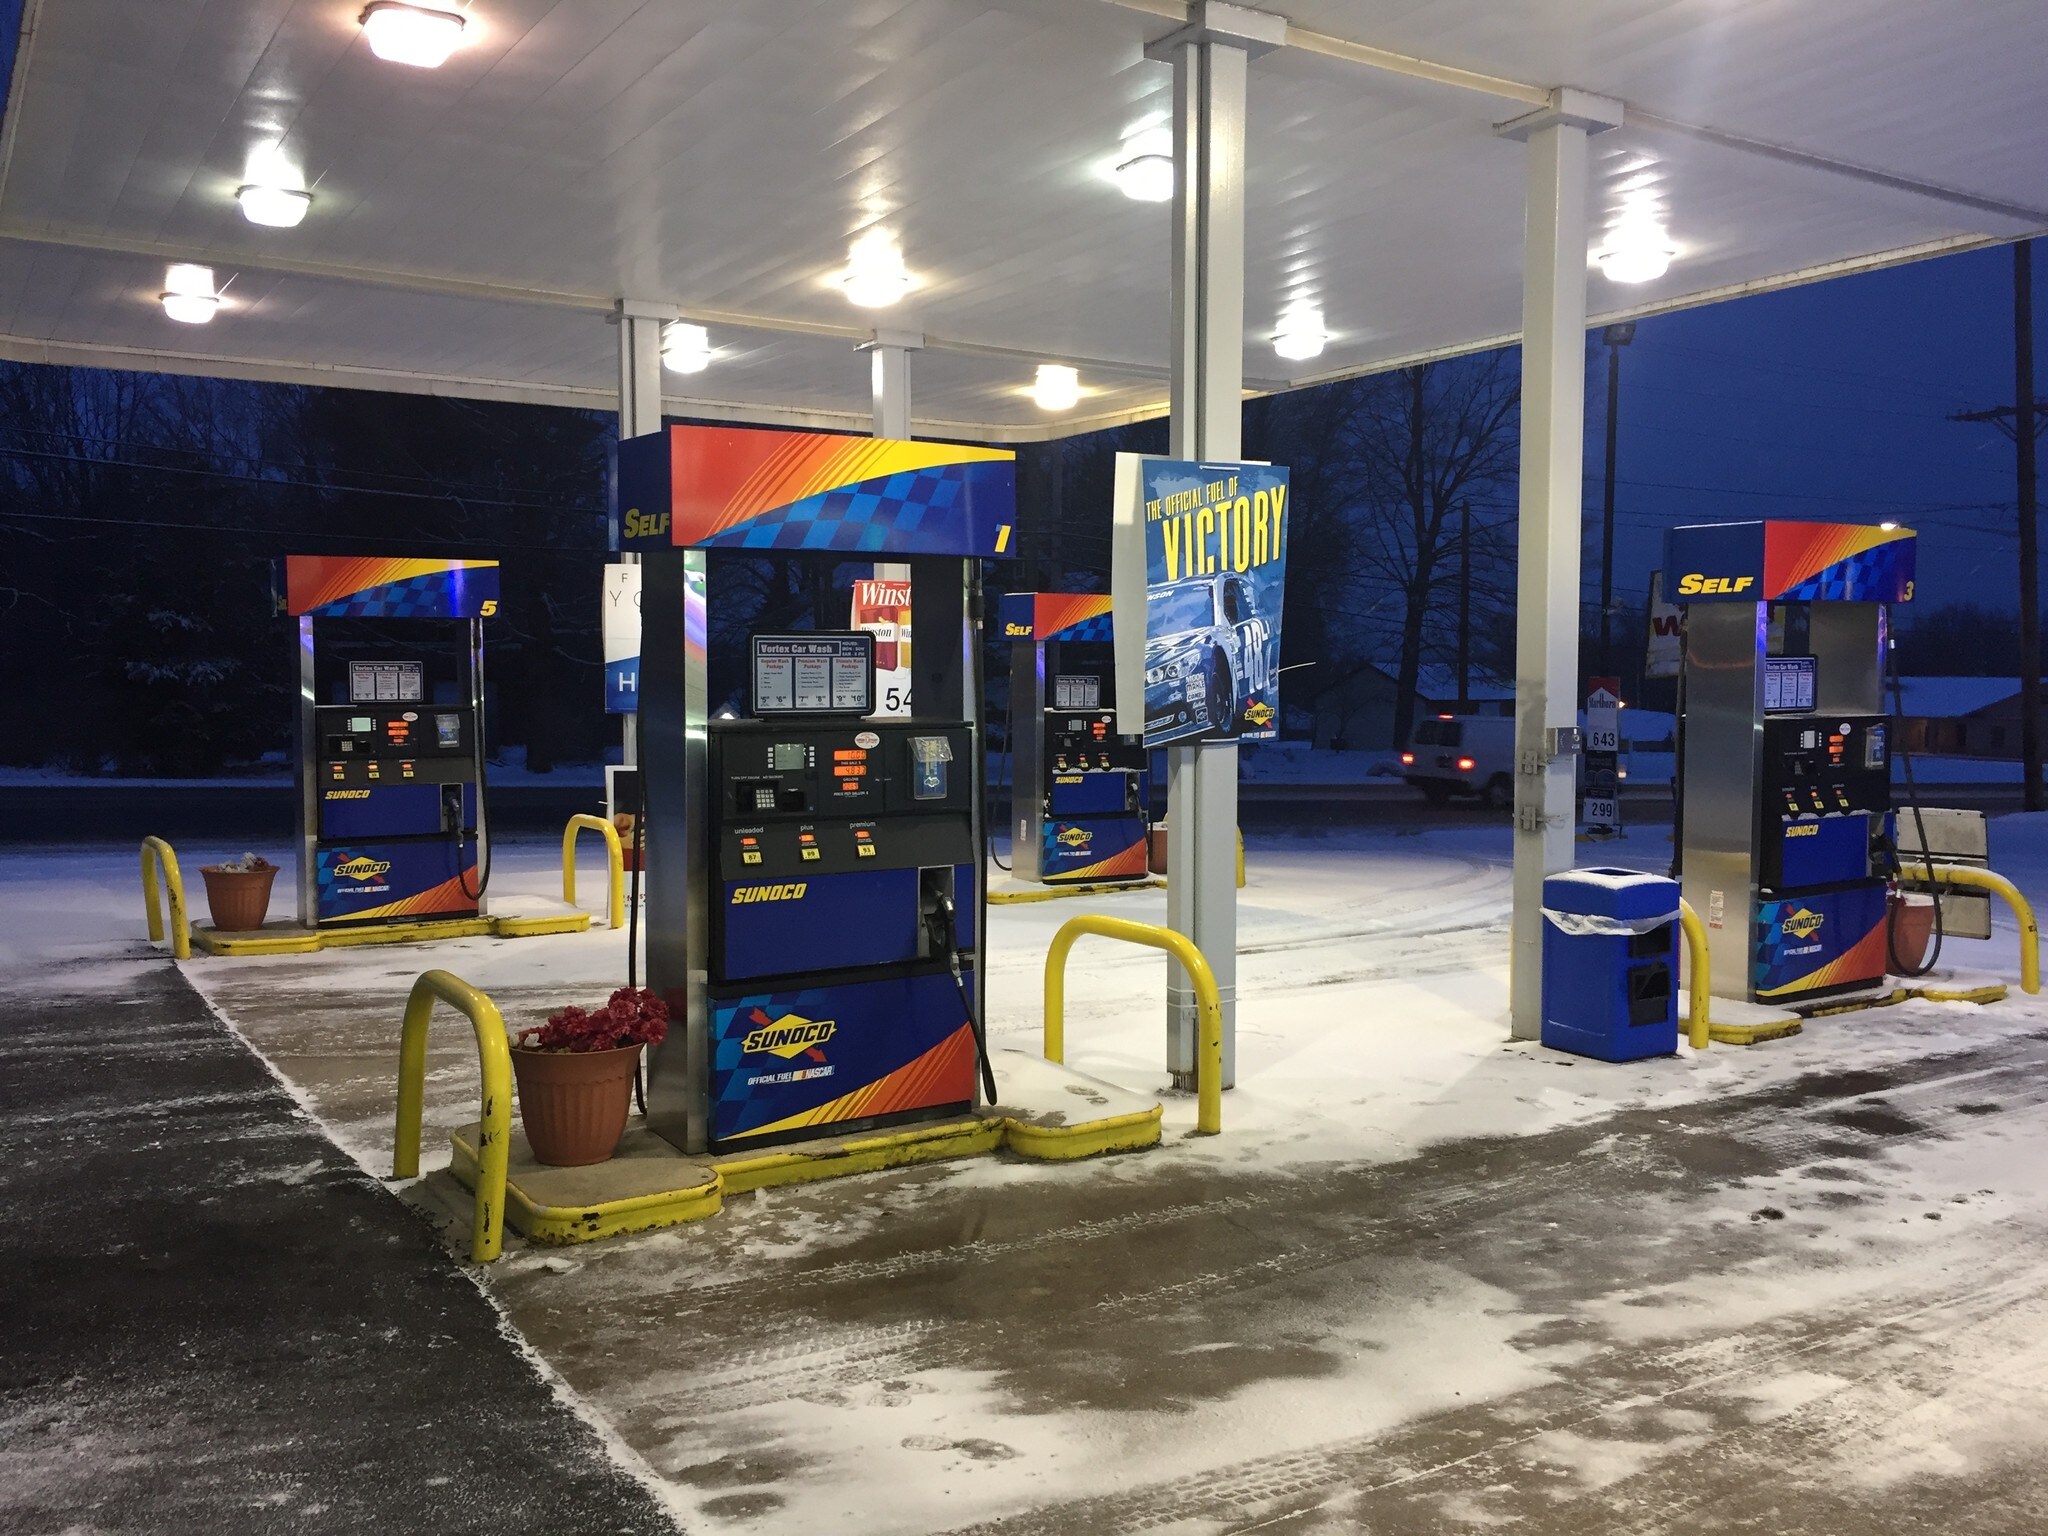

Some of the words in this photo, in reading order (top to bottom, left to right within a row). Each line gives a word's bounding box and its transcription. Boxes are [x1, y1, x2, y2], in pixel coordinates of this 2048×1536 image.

[1146, 501, 1162, 522] THE
[1165, 487, 1203, 516] OFFICIAL
[1206, 479, 1225, 504] FUEL
[1228, 476, 1239, 496] OF
[623, 508, 670, 539] SELF
[994, 524, 1011, 553] 1
[1162, 484, 1287, 582] VICTORY
[1677, 573, 1754, 594] SELF
[1903, 581, 1914, 601] 3
[861, 582, 911, 607] Winst
[479, 600, 498, 617] 5
[1005, 622, 1033, 636] SELF
[761, 644, 790, 653] Vortex
[791, 644, 808, 653] Car
[809, 644, 833, 653] Wash
[1246, 709, 1274, 719] SUNOCO
[1055, 775, 1083, 784] SUNOCO
[325, 789, 371, 800] SUNOCO
[1591, 802, 1613, 817] 299
[734, 826, 764, 834] unleaded
[800, 824, 814, 832] plus
[849, 821, 876, 829] premium
[1785, 825, 1819, 837] SUNOCO
[1058, 832, 1091, 842] SUNOCO
[336, 862, 389, 875] SUNOCO
[731, 883, 807, 904] SUNOCO
[1784, 915, 1822, 931] SUNOCO
[746, 1024, 832, 1050] SUNOCO
[747, 1074, 776, 1086] OFFICIAL
[777, 1071, 793, 1081] FUEL
[806, 1065, 833, 1079] NASCAR
